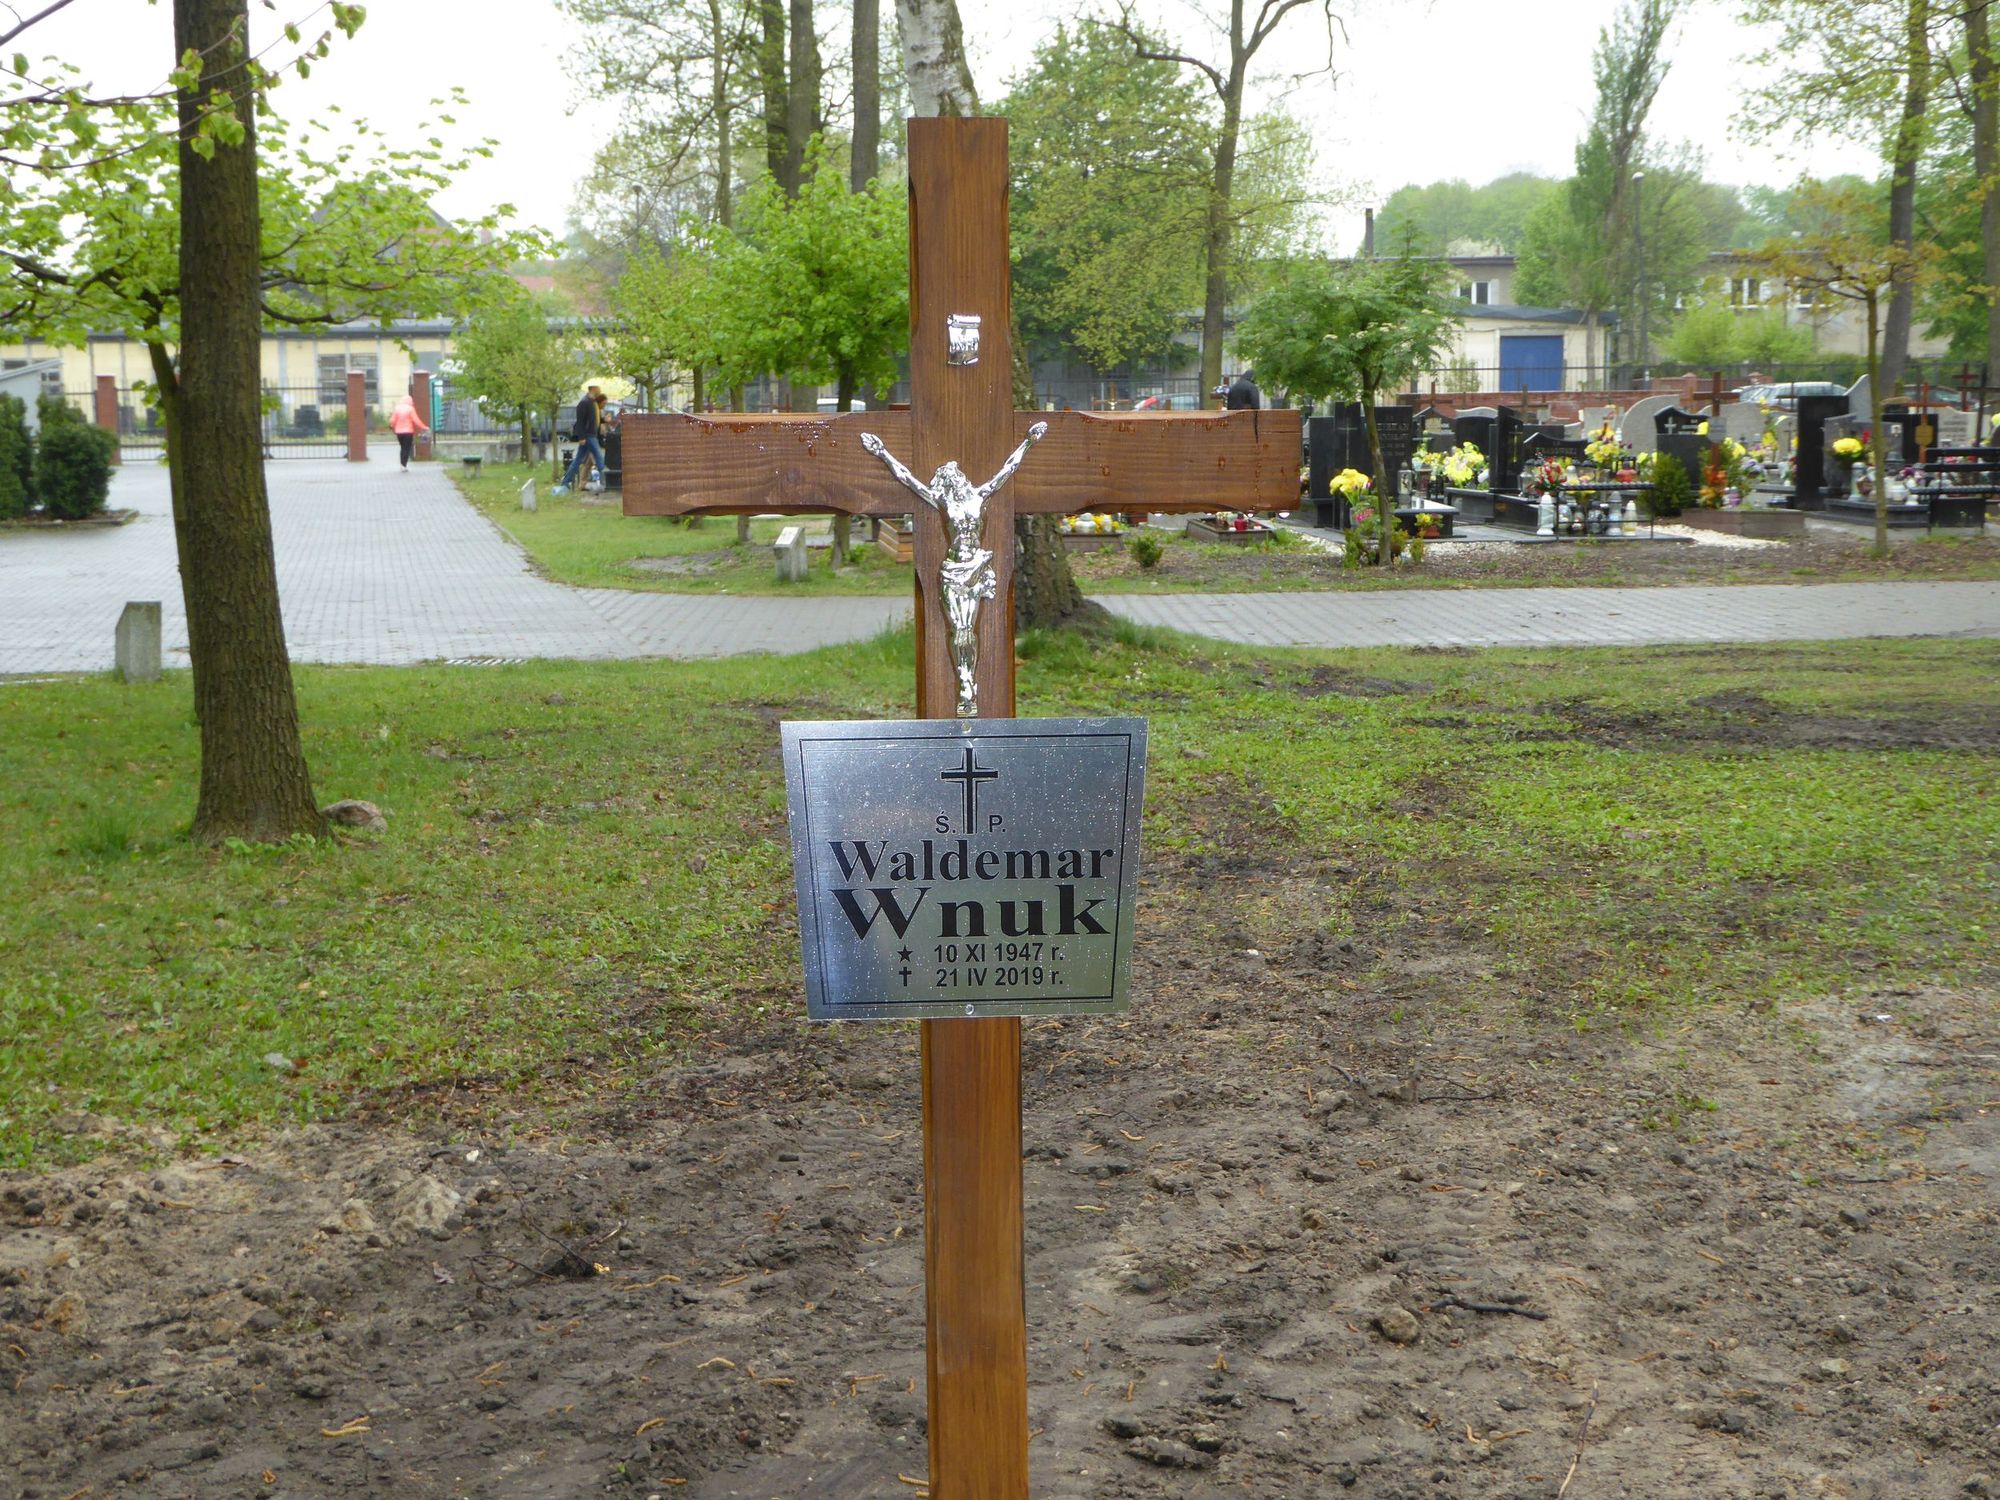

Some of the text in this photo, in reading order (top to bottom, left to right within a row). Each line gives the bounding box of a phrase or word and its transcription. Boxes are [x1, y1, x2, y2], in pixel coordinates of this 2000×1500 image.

[935, 810, 1006, 834] Ś. P.
[828, 839, 1114, 882] Waldemar
[831, 885, 1111, 940] Wnuk
[934, 943, 1064, 963] 10 XI 1947 r.
[936, 967, 1064, 987] 21 IV 2019 r.
